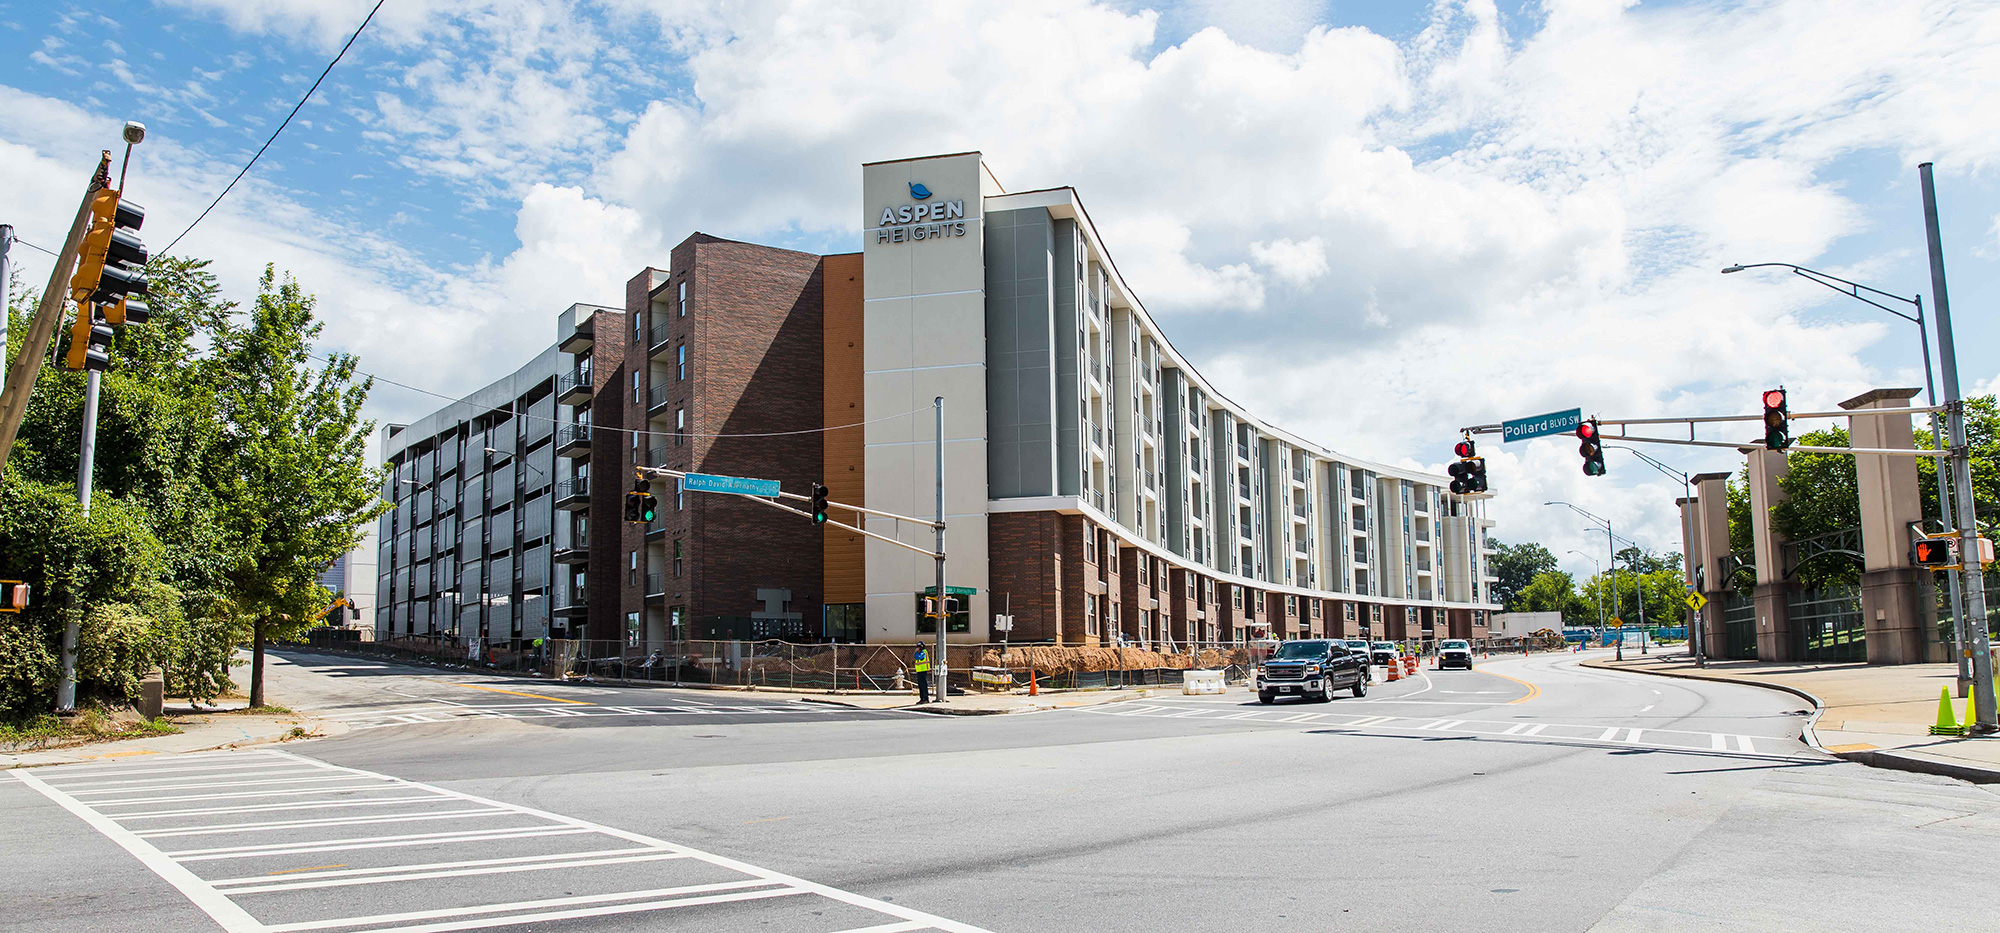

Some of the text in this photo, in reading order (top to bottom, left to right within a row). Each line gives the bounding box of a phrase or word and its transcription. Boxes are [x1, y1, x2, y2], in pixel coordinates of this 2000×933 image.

[879, 200, 964, 226] ASPEN
[877, 221, 966, 244] HEIGHTS
[1504, 415, 1580, 437] Pollard BLVD SW
[688, 477, 706, 487] Ralph
[708, 479, 726, 488] David
